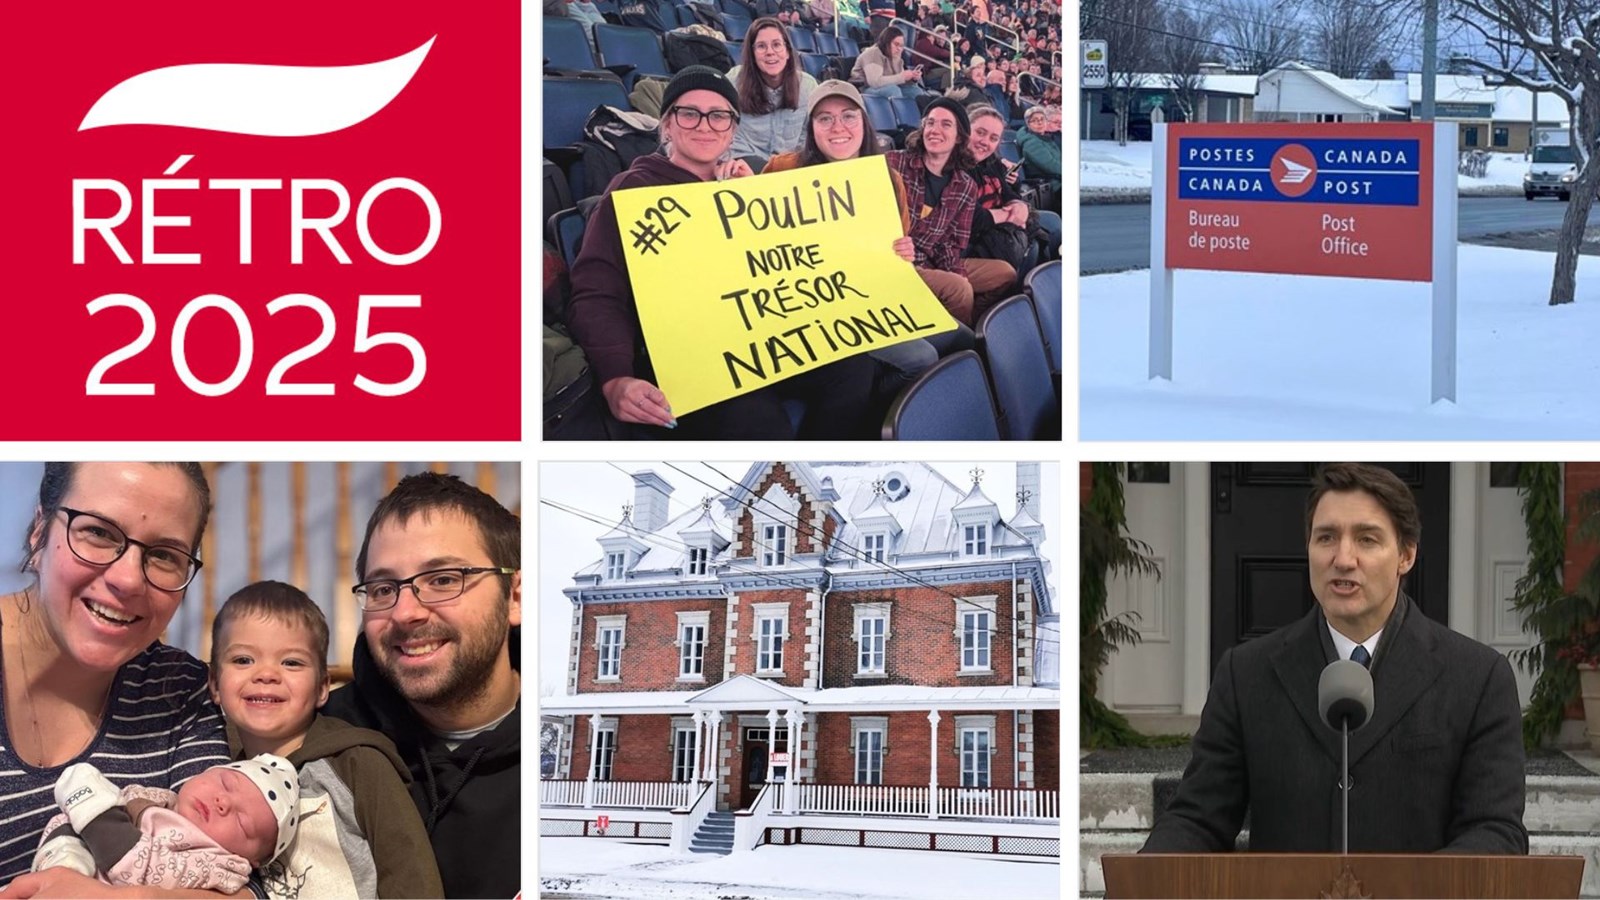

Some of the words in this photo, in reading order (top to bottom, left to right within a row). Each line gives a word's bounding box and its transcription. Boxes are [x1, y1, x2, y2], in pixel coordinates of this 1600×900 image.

[1083, 65, 1106, 79] 2550
[1190, 149, 1254, 162] POSTES
[1325, 150, 1407, 164] CANADA
[1189, 177, 1263, 192] CANADA
[1325, 180, 1372, 194] POST
[629, 196, 692, 256] #29
[1189, 210, 1240, 228] Bureau
[1322, 213, 1355, 232] Post
[1188, 232, 1206, 249] de
[1210, 235, 1250, 253] poste
[1322, 236, 1369, 256] Office
[745, 244, 825, 278] NOTRE
[721, 270, 869, 331] TRÉSOR
